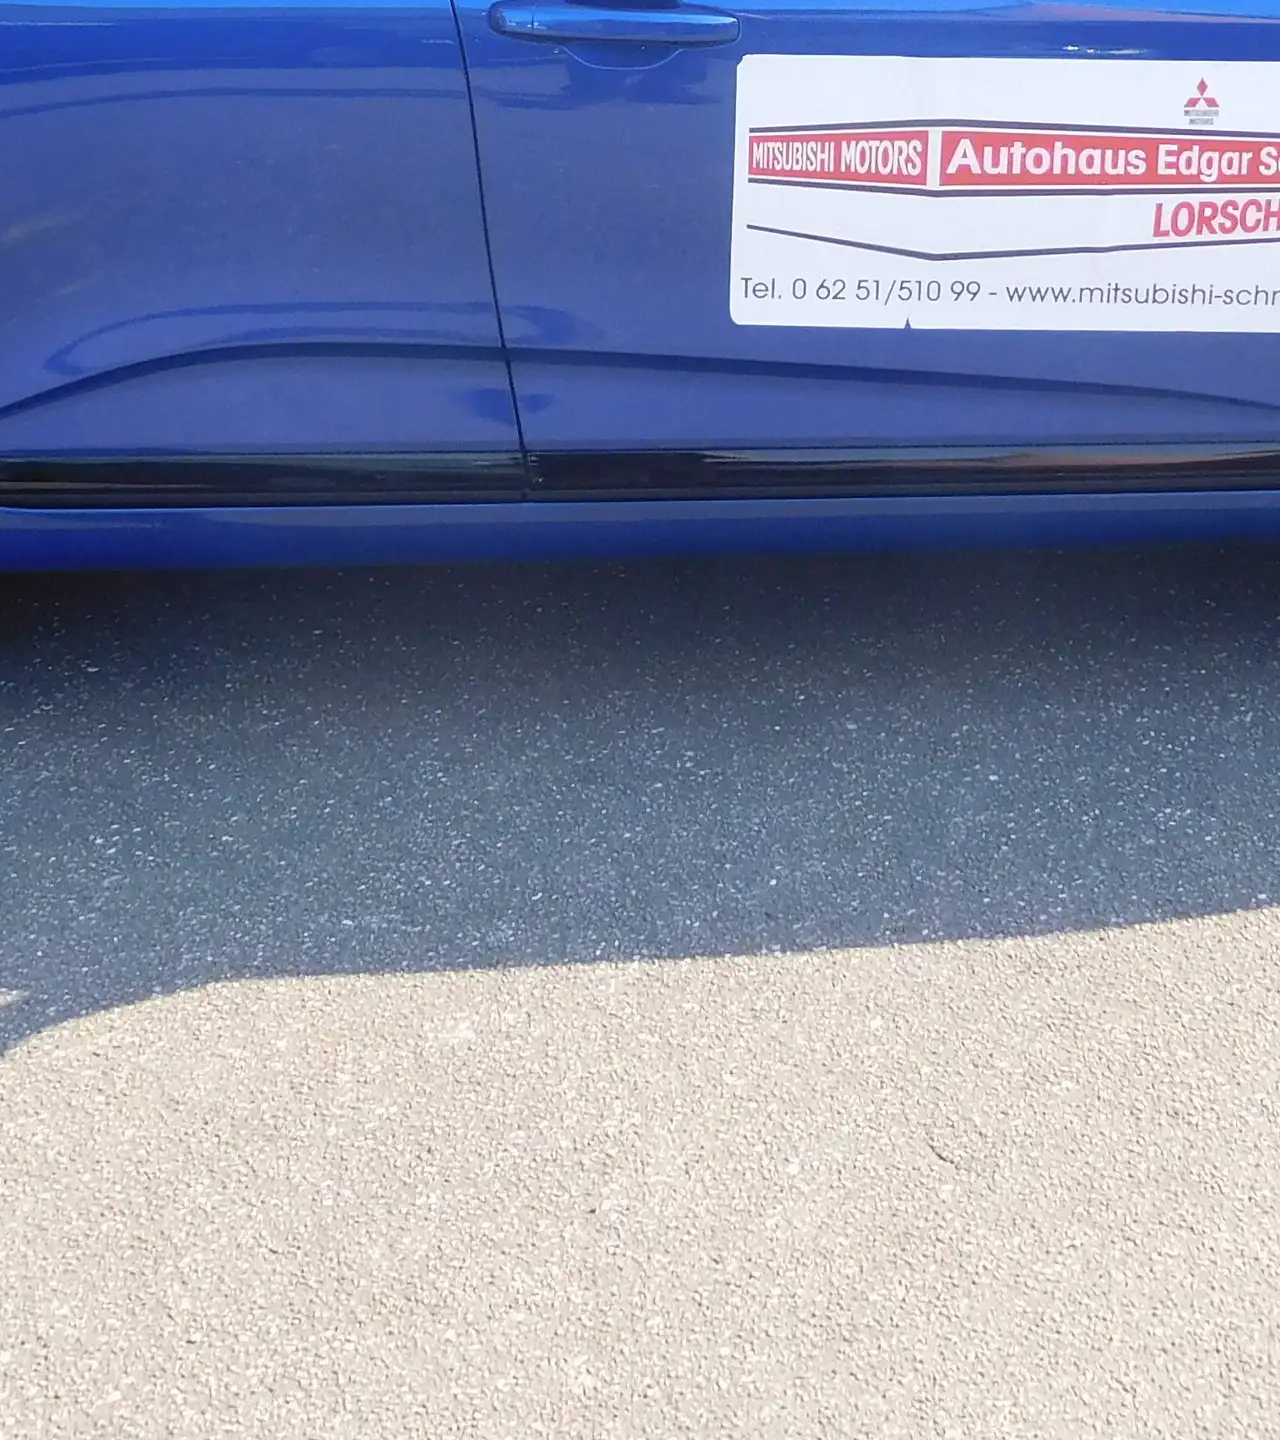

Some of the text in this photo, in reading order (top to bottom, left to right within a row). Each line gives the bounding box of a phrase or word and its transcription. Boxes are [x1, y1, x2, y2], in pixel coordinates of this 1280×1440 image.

[752, 138, 922, 176] MITSUBISHI MOTORS
[945, 138, 1146, 175] Autohaus
[1157, 143, 1252, 182] Edgar
[740, 277, 782, 299] Tel.
[792, 278, 807, 300] 0
[816, 278, 846, 300] 62
[855, 279, 942, 305] 51/510
[950, 280, 980, 301] 99
